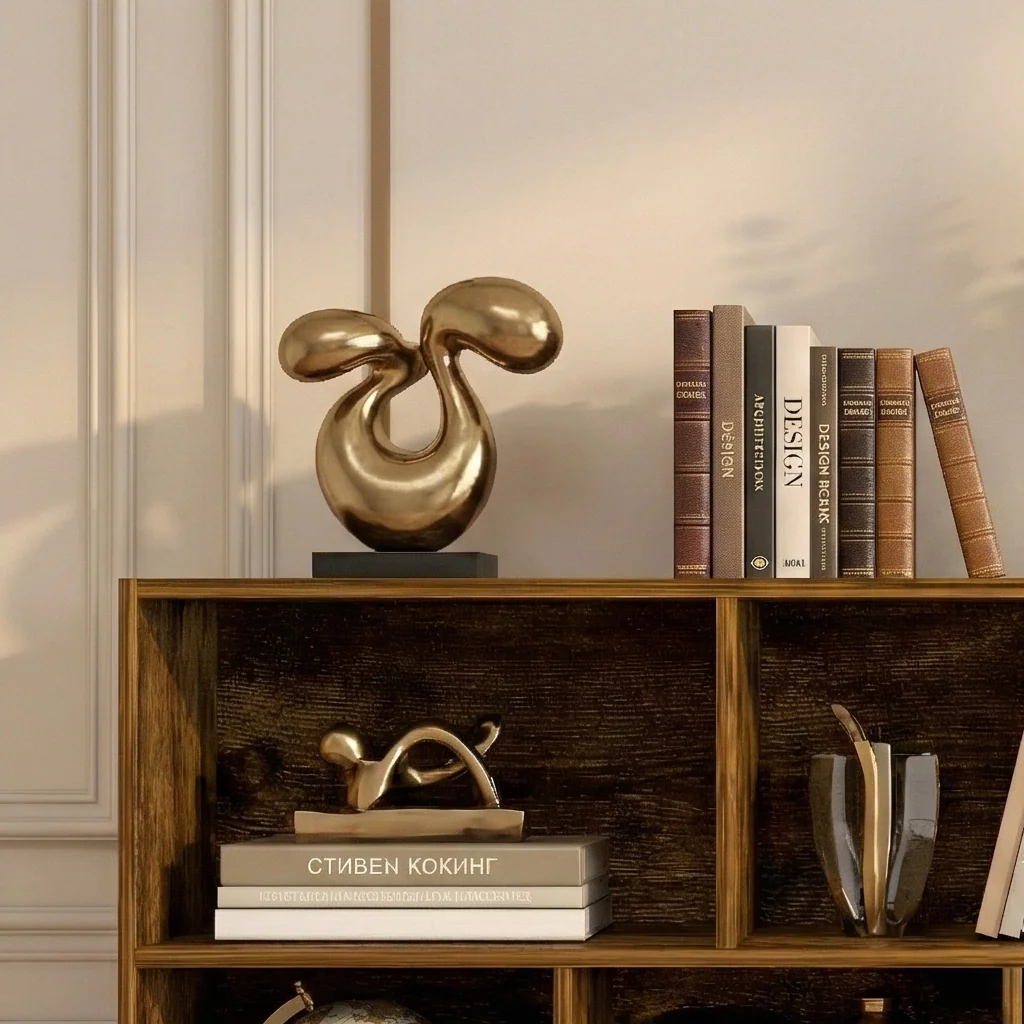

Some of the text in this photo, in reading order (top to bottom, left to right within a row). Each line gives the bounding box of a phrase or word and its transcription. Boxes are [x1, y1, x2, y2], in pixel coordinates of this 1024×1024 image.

[783, 396, 804, 488] DESIGN
[818, 424, 830, 476] DESIGN
[408, 857, 498, 875] КОКИНГ
